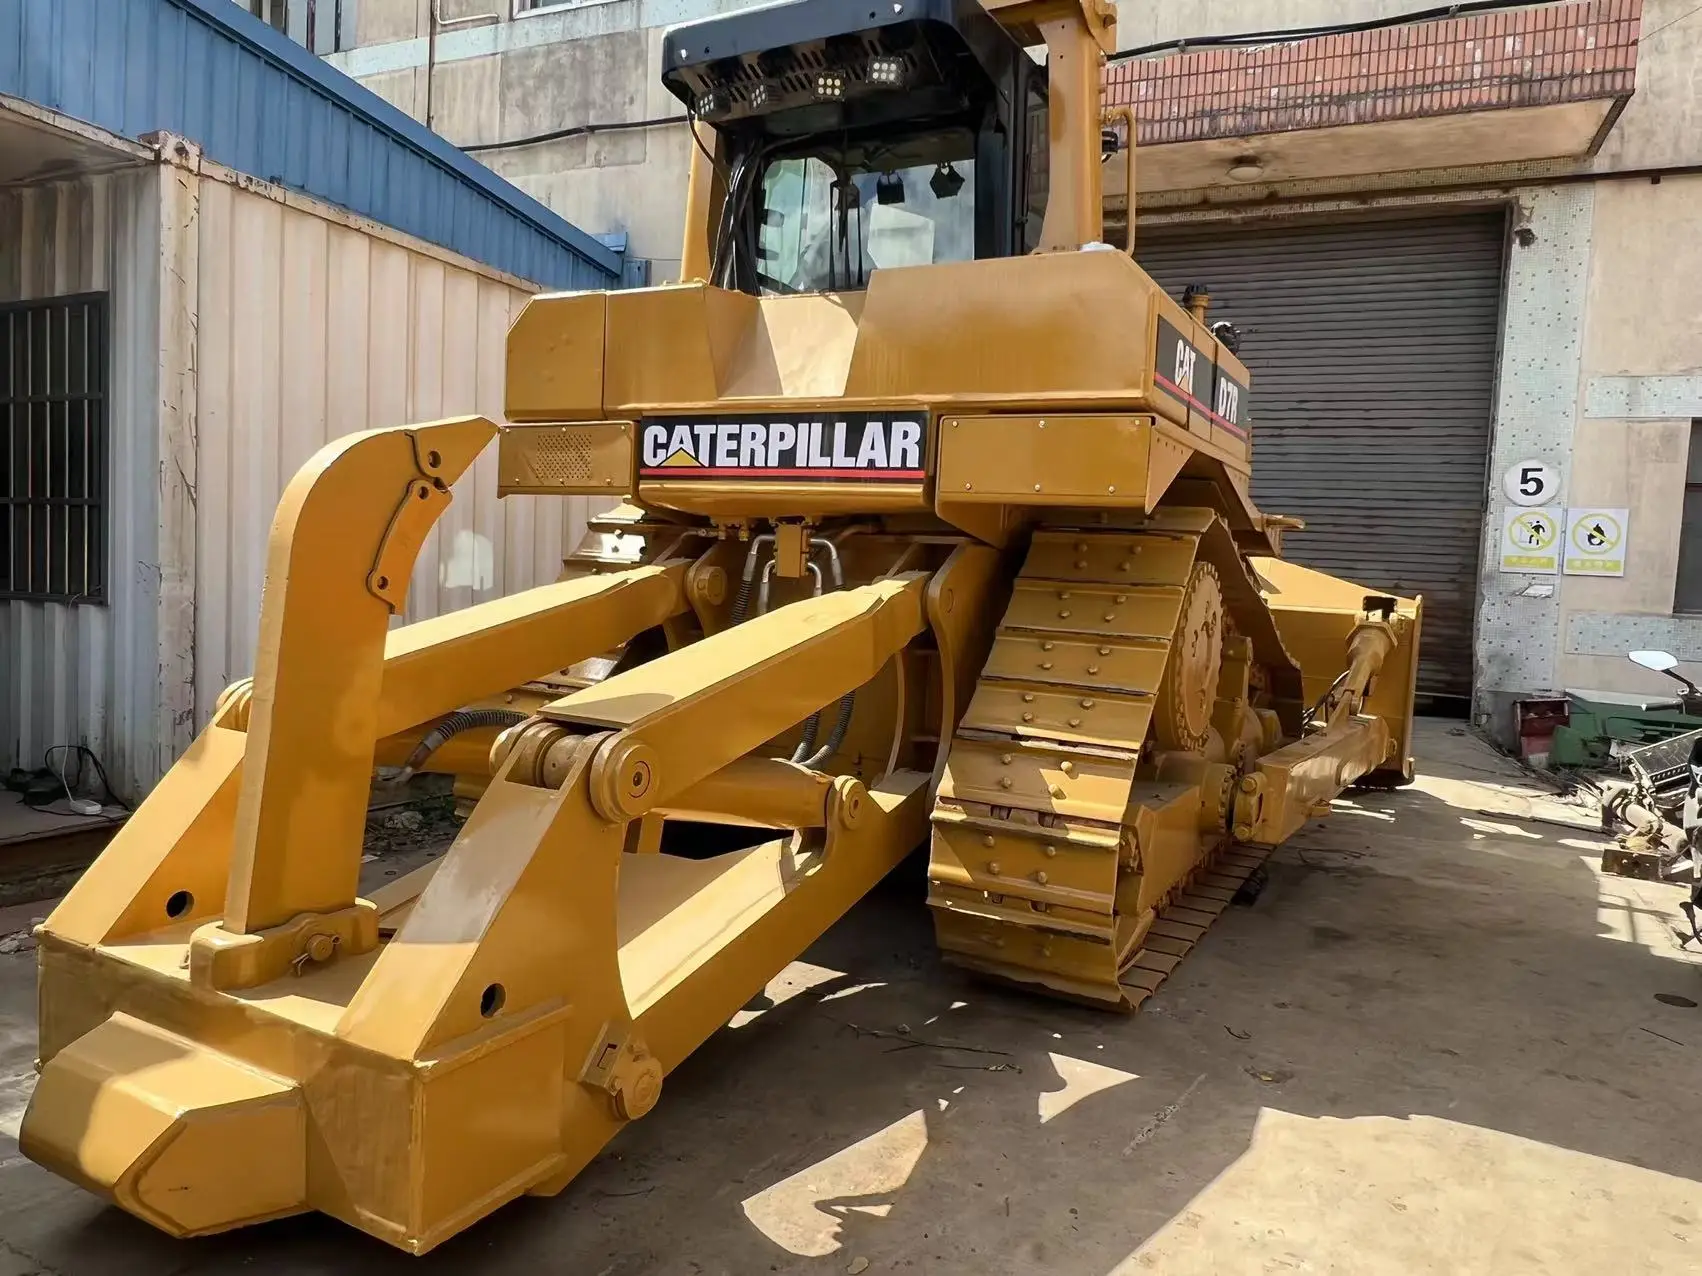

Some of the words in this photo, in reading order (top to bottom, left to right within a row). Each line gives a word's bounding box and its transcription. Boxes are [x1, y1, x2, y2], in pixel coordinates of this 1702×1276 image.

[1175, 339, 1196, 396] CAT
[1218, 377, 1238, 424] D7R
[643, 421, 921, 468] CATERPILLAR
[1519, 467, 1544, 496] 5
